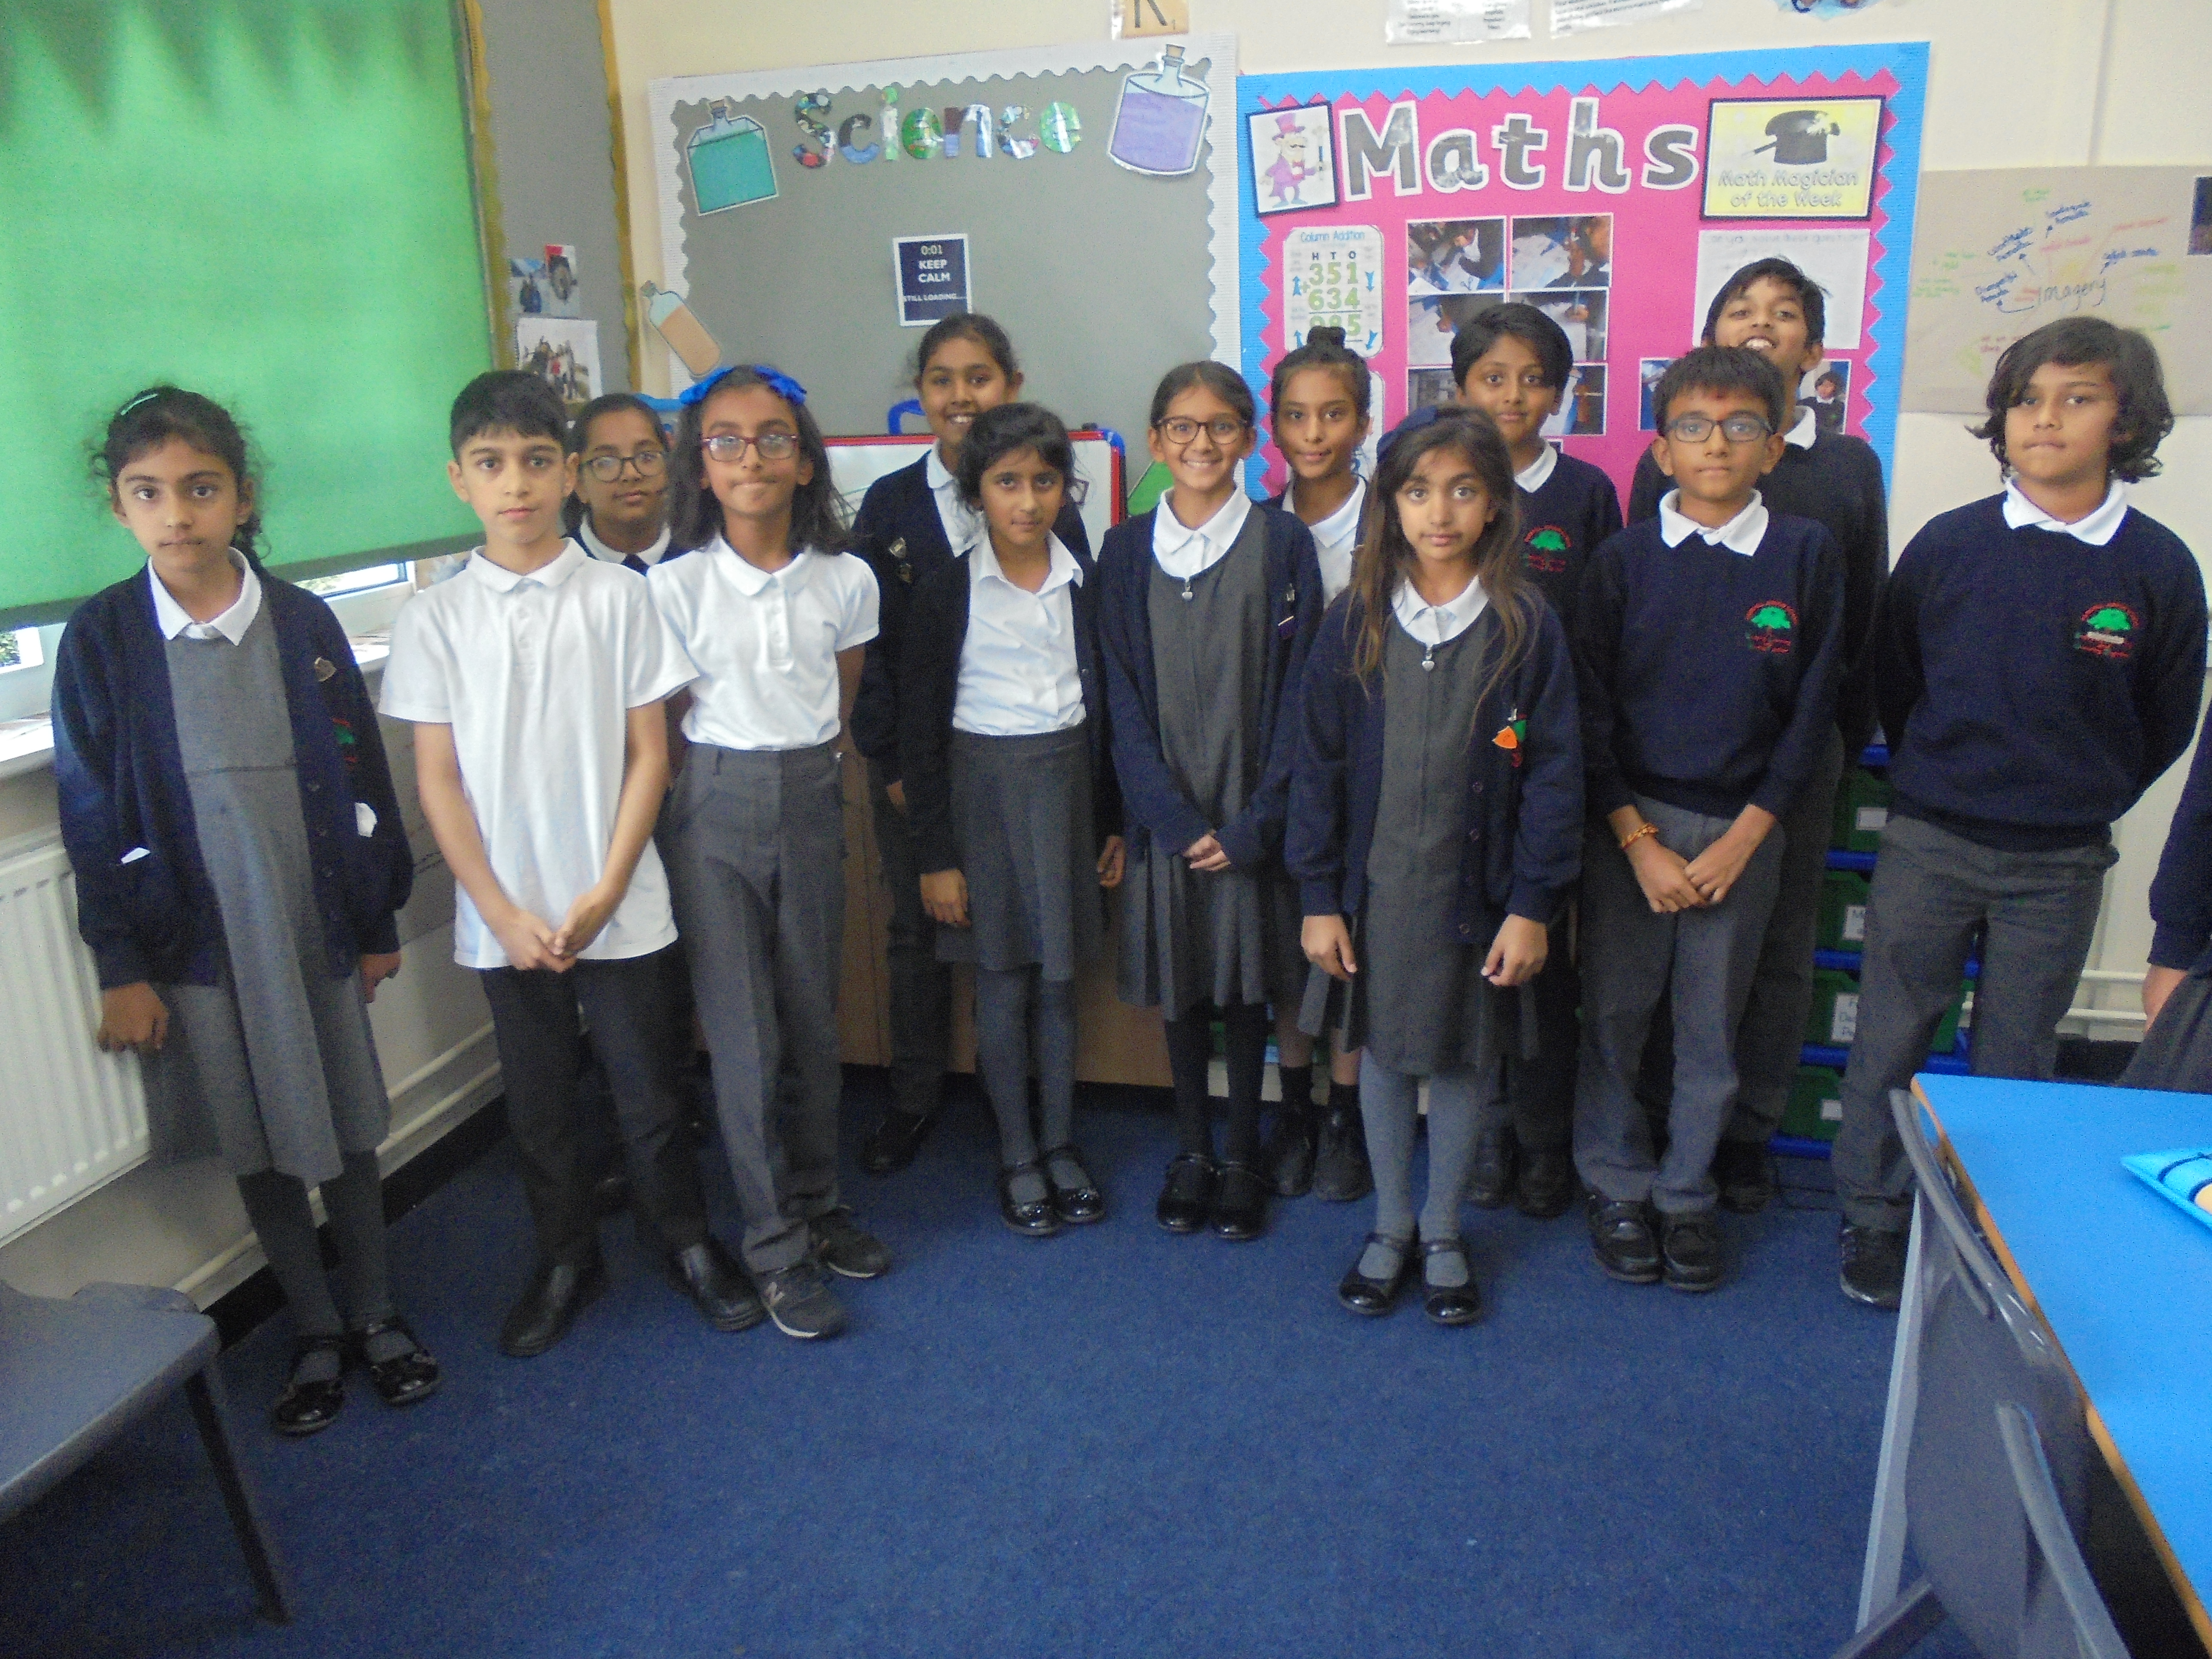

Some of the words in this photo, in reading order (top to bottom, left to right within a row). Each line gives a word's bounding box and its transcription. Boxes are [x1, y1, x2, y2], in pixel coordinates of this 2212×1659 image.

[792, 85, 1082, 169] Science
[1339, 97, 1699, 202] Maths
[1771, 169, 1860, 189] Magician
[1730, 191, 1753, 207] of
[1757, 192, 1789, 207] the
[1795, 191, 1843, 207] Week
[921, 245, 943, 255] 0:01
[1312, 252, 1320, 260] H
[1348, 250, 1357, 259] O
[918, 258, 948, 270] KEEP
[918, 272, 951, 283] CALM
